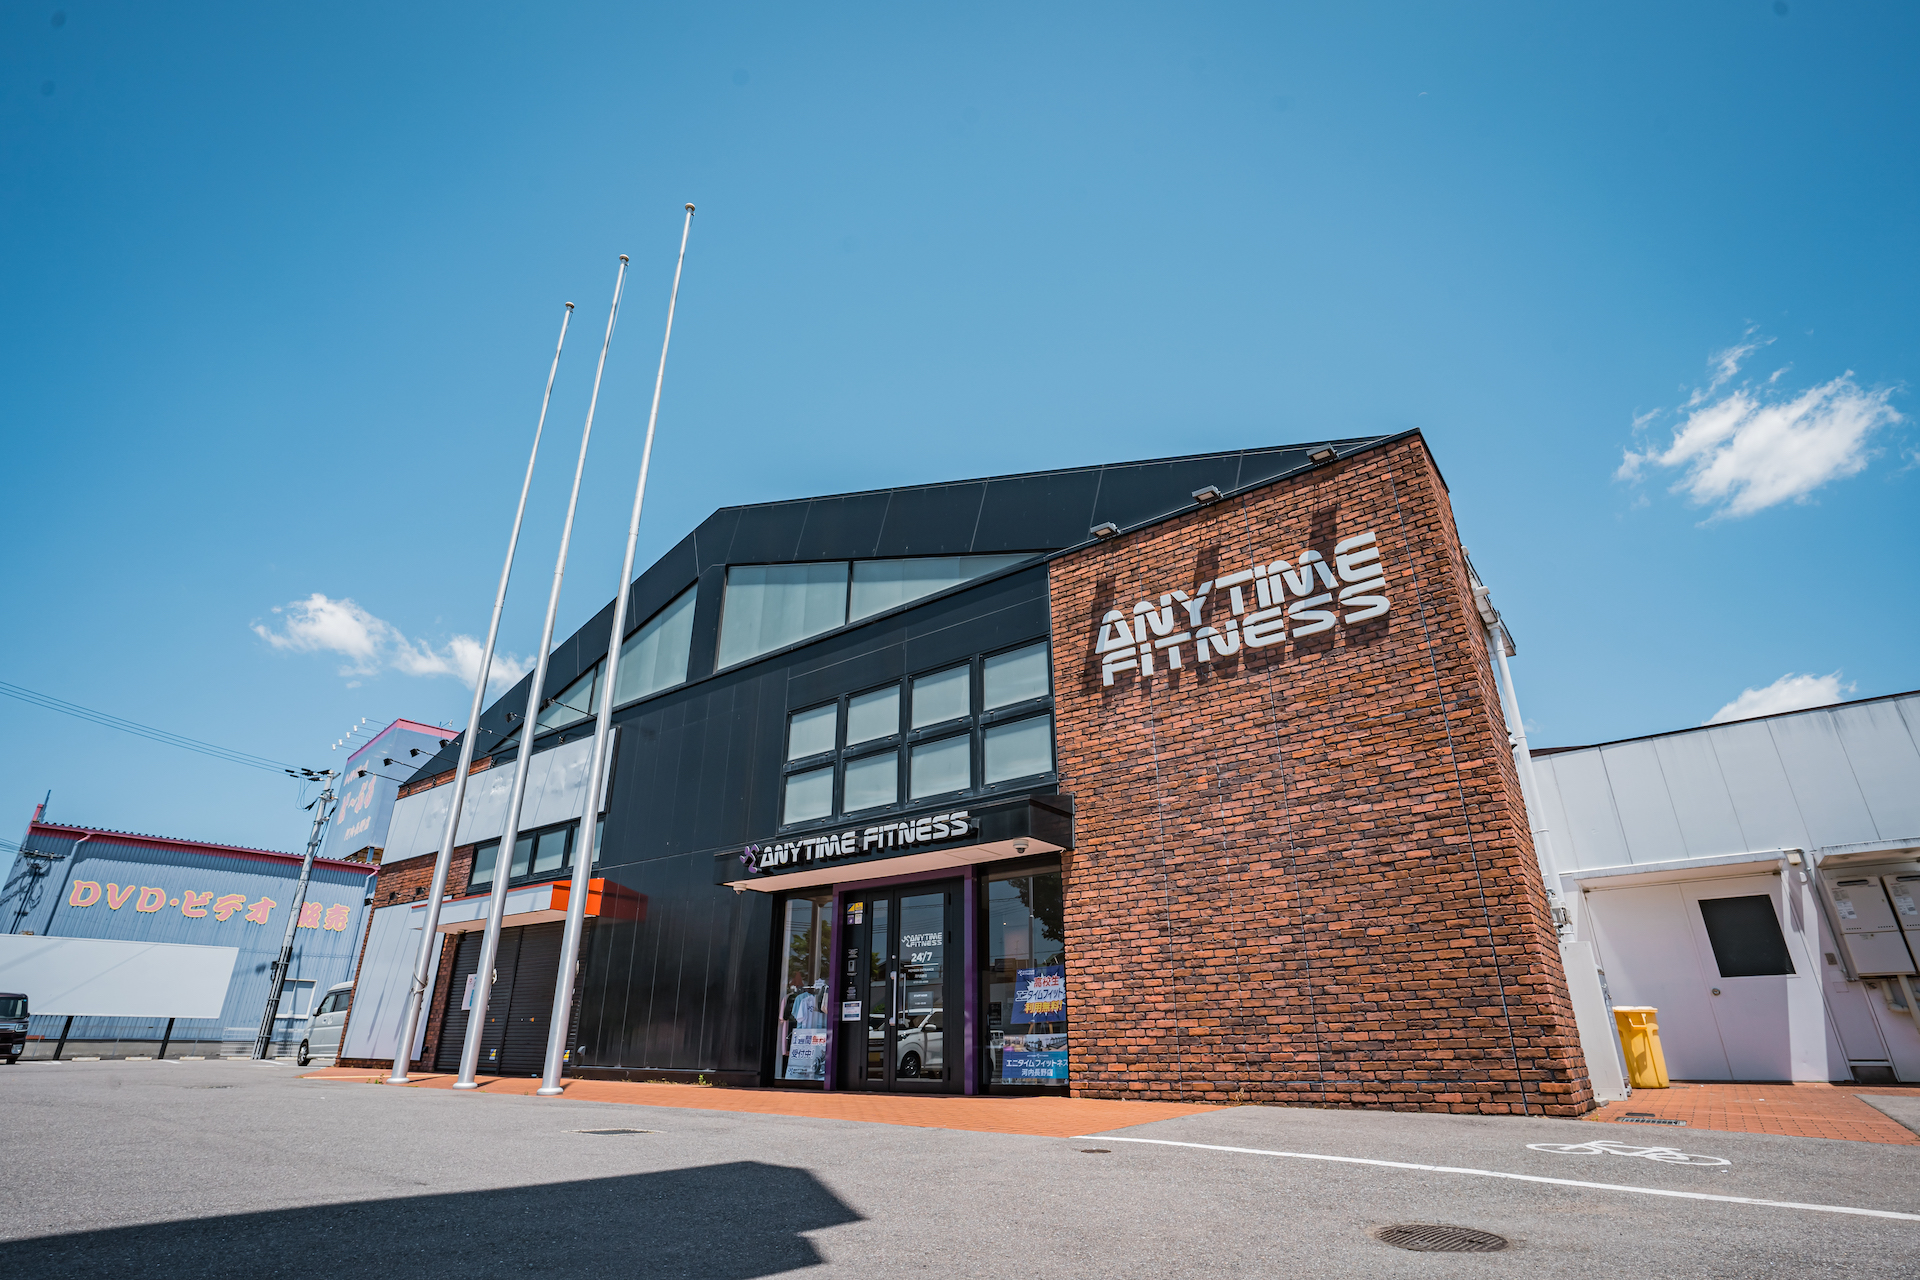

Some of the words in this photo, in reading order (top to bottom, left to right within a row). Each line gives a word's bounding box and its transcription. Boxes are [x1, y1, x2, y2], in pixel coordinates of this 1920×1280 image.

[1095, 531, 1384, 654] ANYTIME
[1101, 577, 1391, 687] FITNESS
[760, 830, 856, 868] ANYTIME
[863, 810, 970, 851] FITNESS
[910, 932, 942, 942] ANYTIME
[911, 951, 933, 963] 24/7
[1034, 975, 1060, 988] 高校生
[1021, 1068, 1054, 1077] 河内長野店
